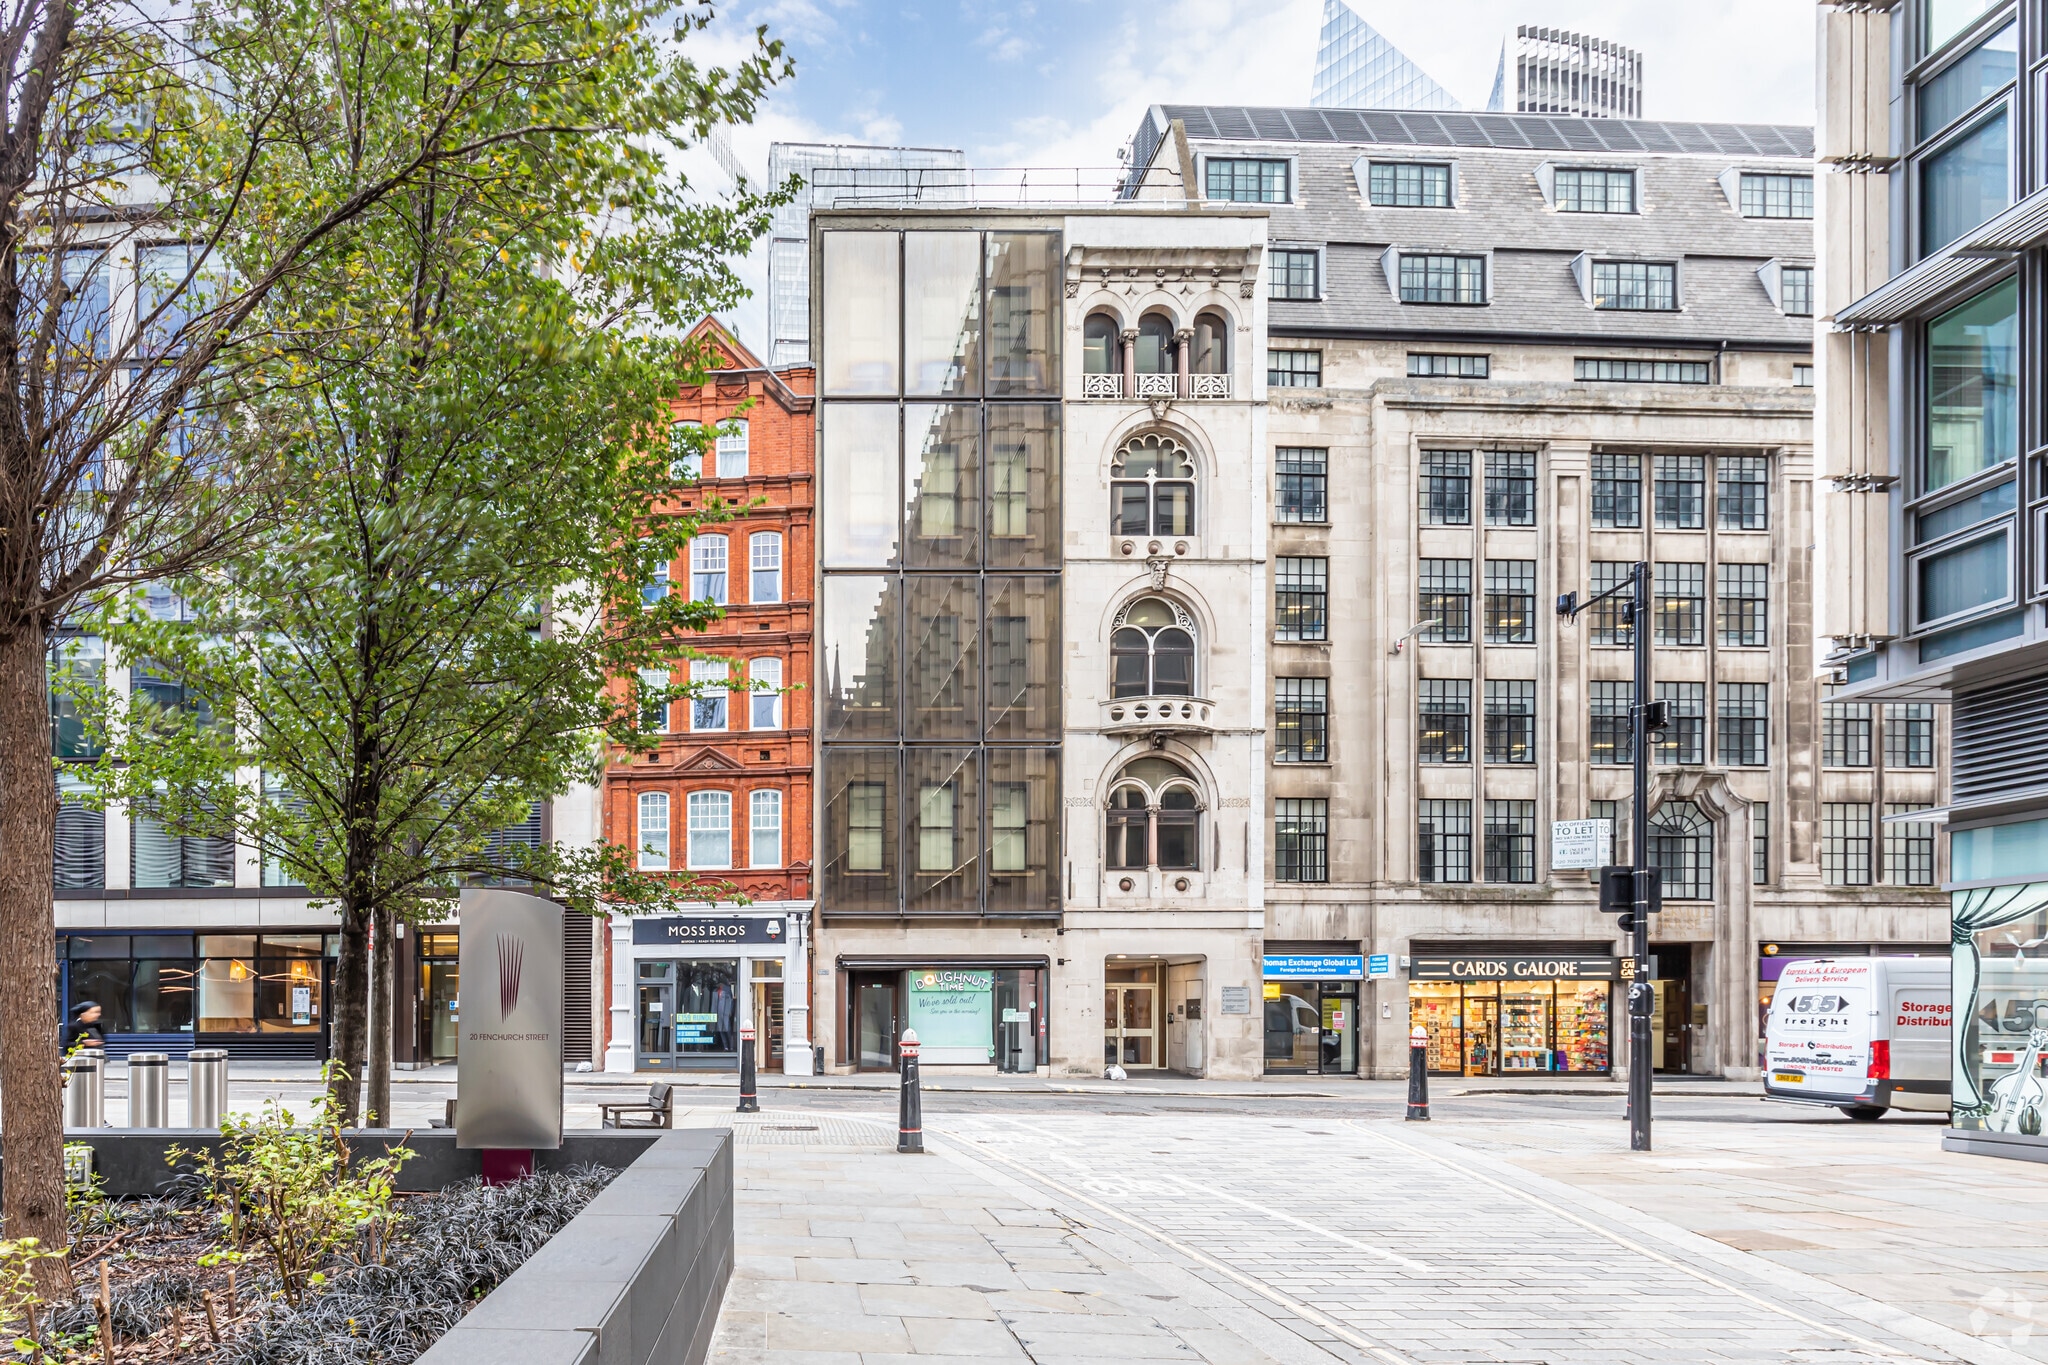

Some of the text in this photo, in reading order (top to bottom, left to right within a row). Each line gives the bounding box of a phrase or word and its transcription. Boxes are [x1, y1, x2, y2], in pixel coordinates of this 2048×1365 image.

[1555, 826, 1594, 836] TO LET
[668, 925, 746, 937] MOSS BROS
[1288, 958, 1321, 967] Exchange
[1323, 958, 1345, 967] Global
[1346, 958, 1358, 967] Ltd
[1452, 960, 1578, 977] CARDS GALORE
[1786, 968, 1807, 976] Express
[1830, 966, 1868, 974] European
[915, 971, 989, 990] DOUGHNUT
[939, 982, 965, 991] TIME
[919, 993, 976, 1008] We've sold out!
[1797, 994, 1837, 1015] 505
[1901, 1001, 1952, 1014] Storage
[1785, 1017, 1848, 1027] freight
[469, 1033, 550, 1041] 20 FENCHURCH STREET
